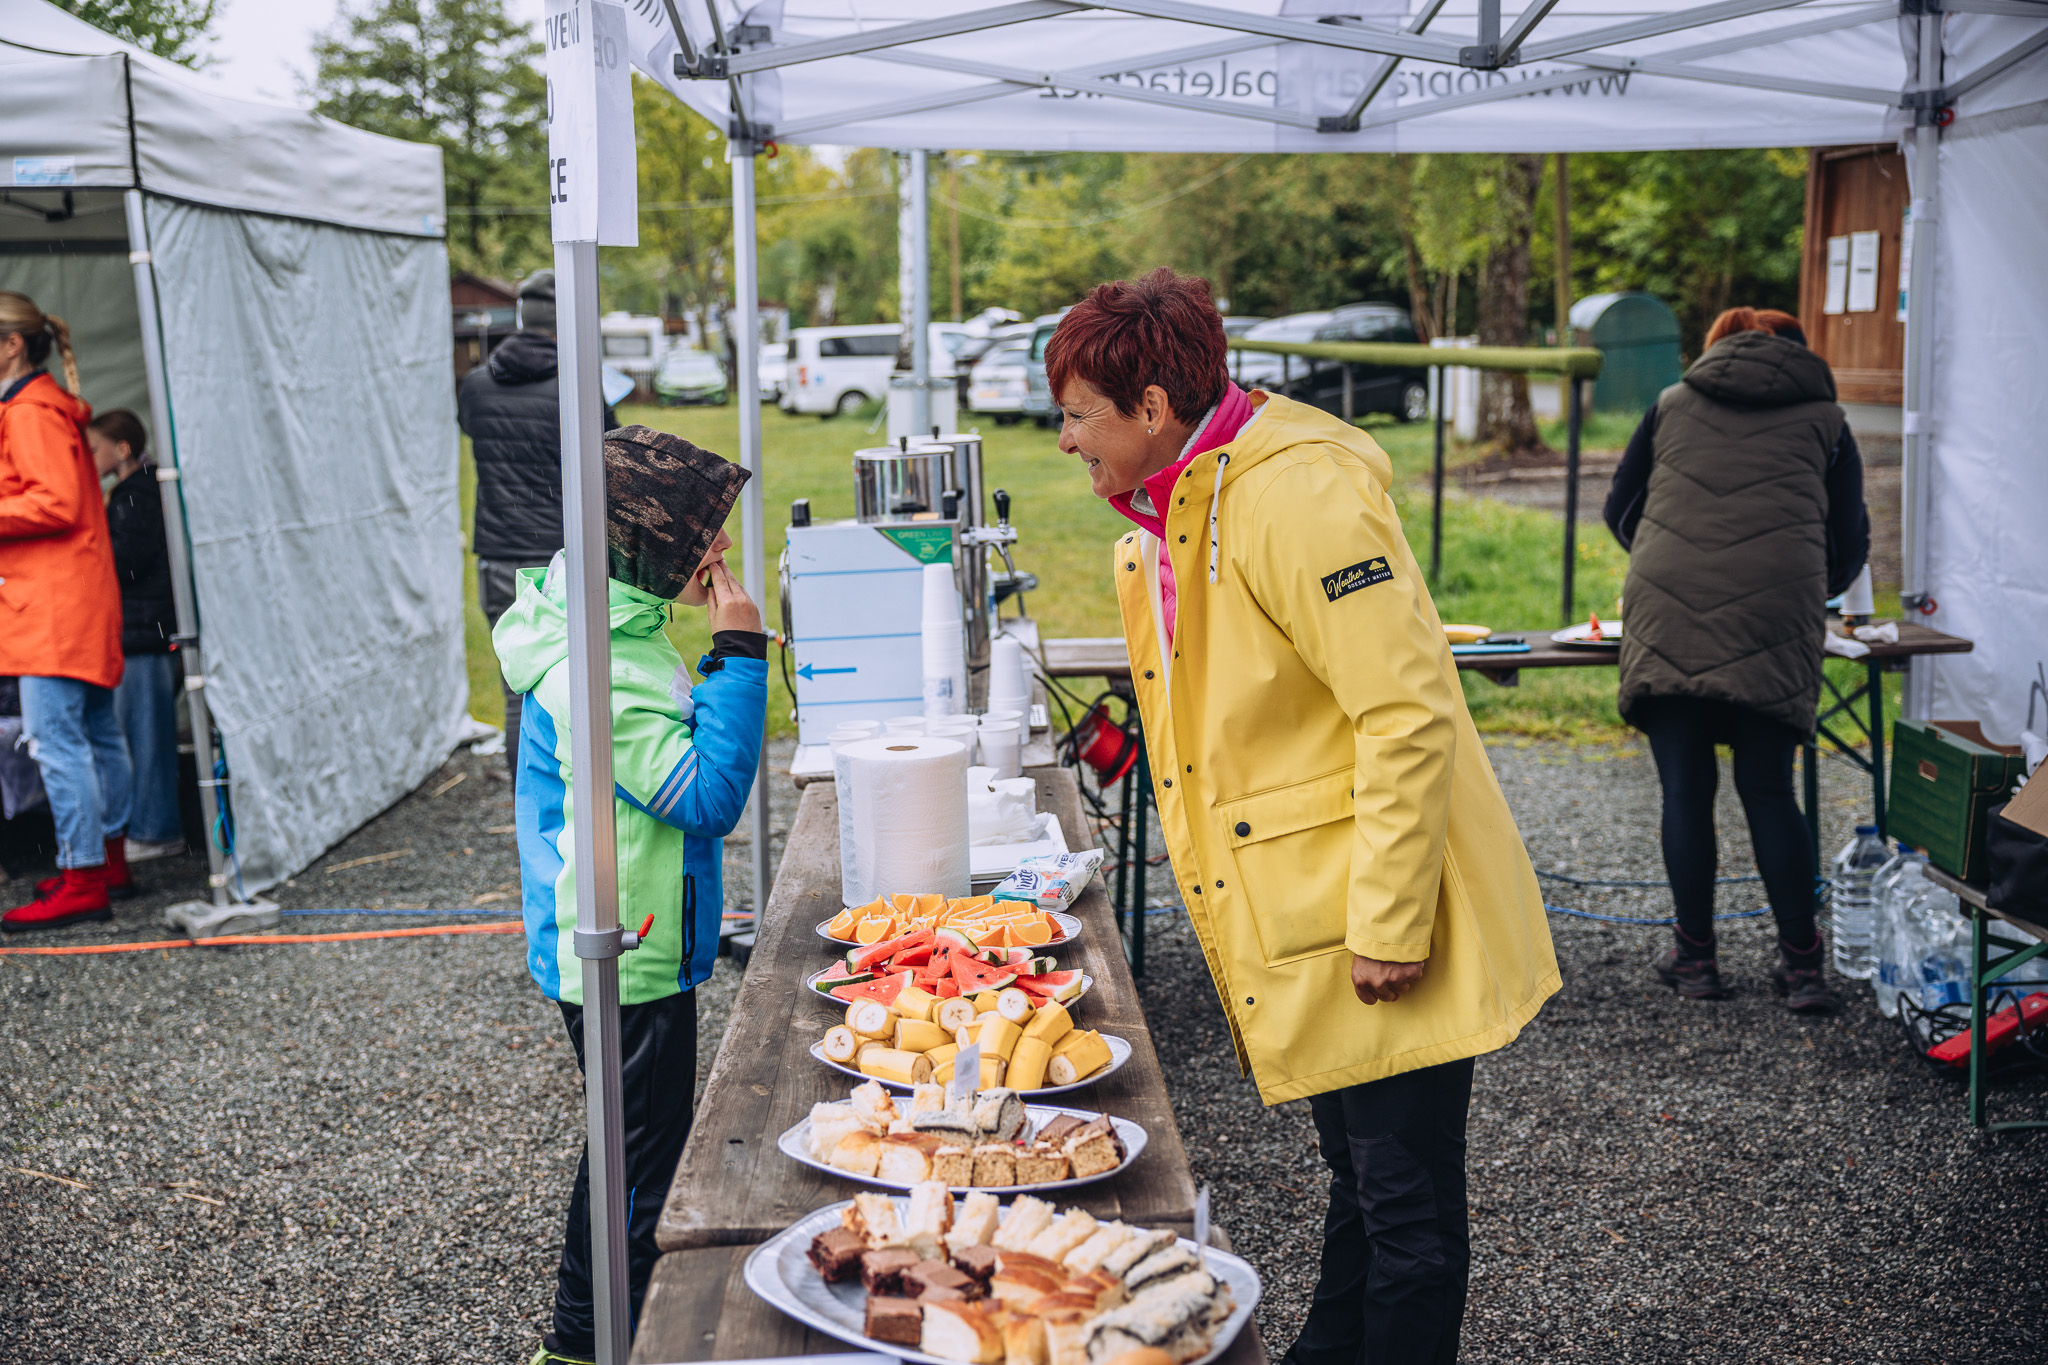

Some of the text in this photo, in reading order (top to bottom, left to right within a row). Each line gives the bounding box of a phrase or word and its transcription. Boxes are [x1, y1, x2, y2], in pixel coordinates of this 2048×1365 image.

[897, 531, 926, 539] GREEN
[1327, 570, 1364, 597] Weather
[1347, 571, 1391, 589] DOESN'T MATTER
